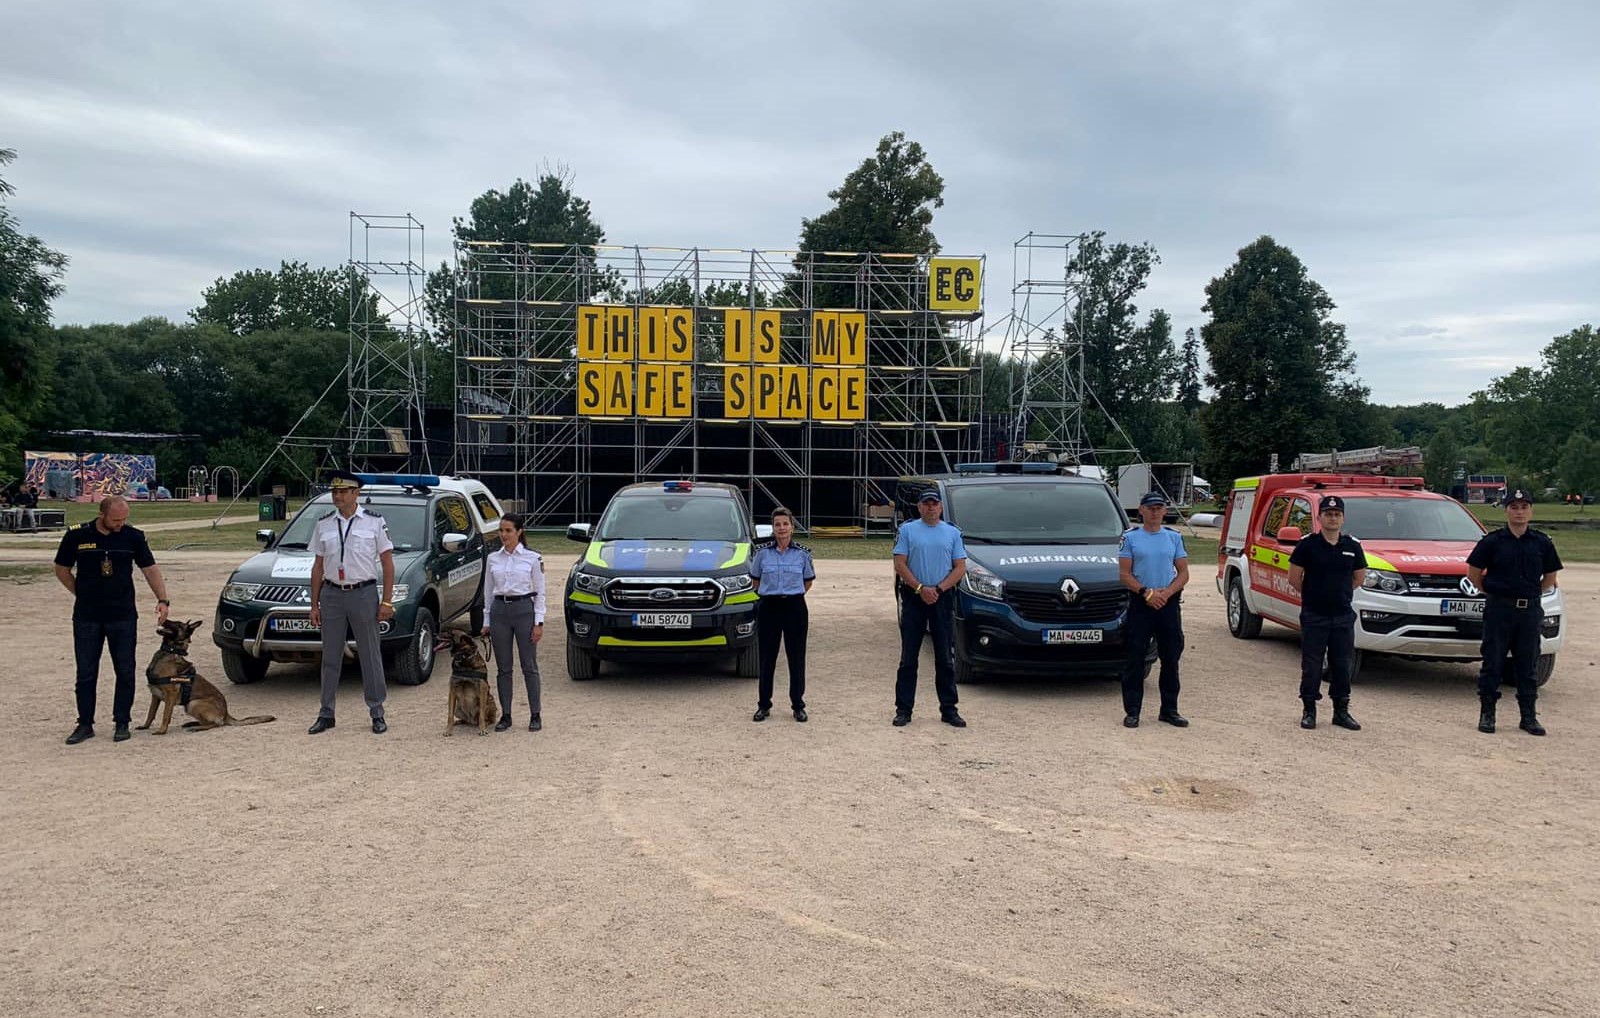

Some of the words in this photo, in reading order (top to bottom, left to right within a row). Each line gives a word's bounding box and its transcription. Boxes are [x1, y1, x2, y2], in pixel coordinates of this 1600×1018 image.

[936, 266, 974, 302] EC
[584, 313, 688, 353] THIS
[734, 319, 775, 354] IS
[815, 319, 860, 356] MY
[583, 370, 686, 408] SAFE
[730, 372, 860, 411] SPACE
[1449, 602, 1466, 613] MAI
[1472, 602, 1485, 613] 46
[277, 620, 294, 630] MAI
[640, 615, 656, 625] MAI
[658, 615, 689, 625] 58740
[1050, 630, 1065, 641] MAI
[1071, 630, 1100, 641] 49445
